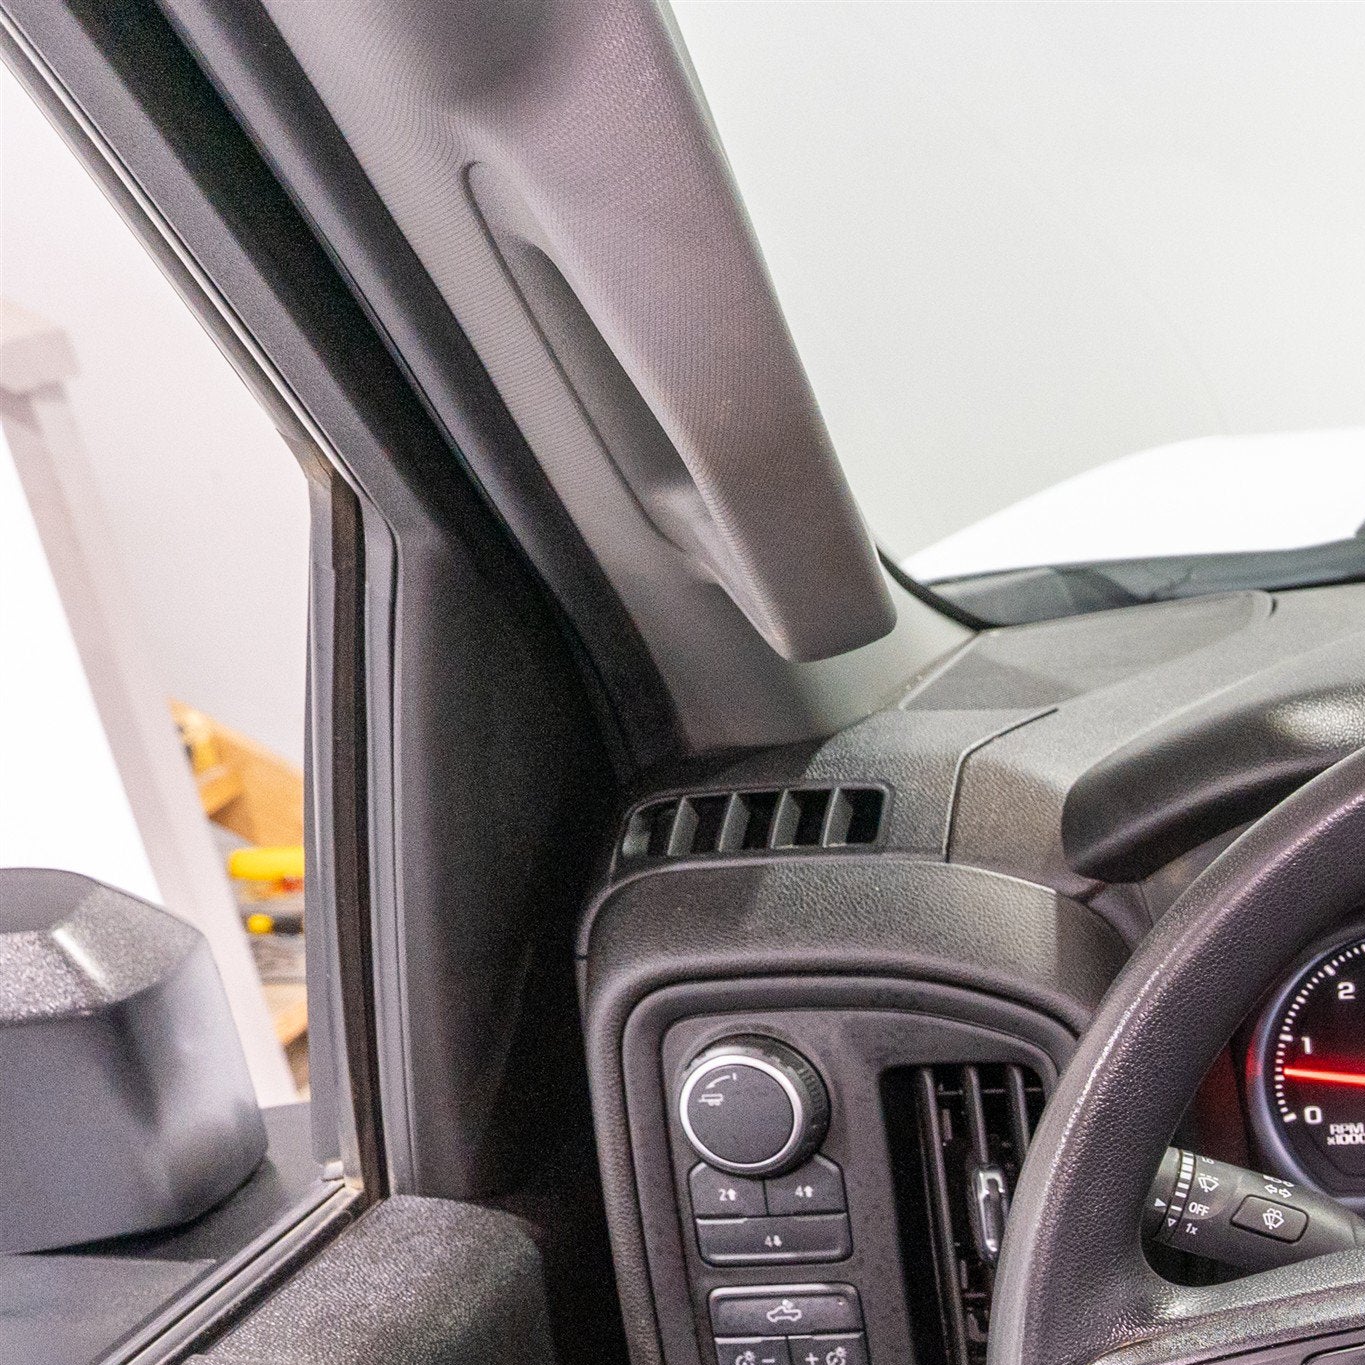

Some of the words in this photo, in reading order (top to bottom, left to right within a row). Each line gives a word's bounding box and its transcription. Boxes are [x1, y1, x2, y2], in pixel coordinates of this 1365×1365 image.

[1337, 982, 1356, 1000] 2
[1301, 1036, 1313, 1054] 1
[1304, 1105, 1322, 1125] 0
[1329, 1122, 1365, 1136] RPM
[1189, 1202, 1210, 1216] OFF
[1185, 1223, 1198, 1235] 1x
